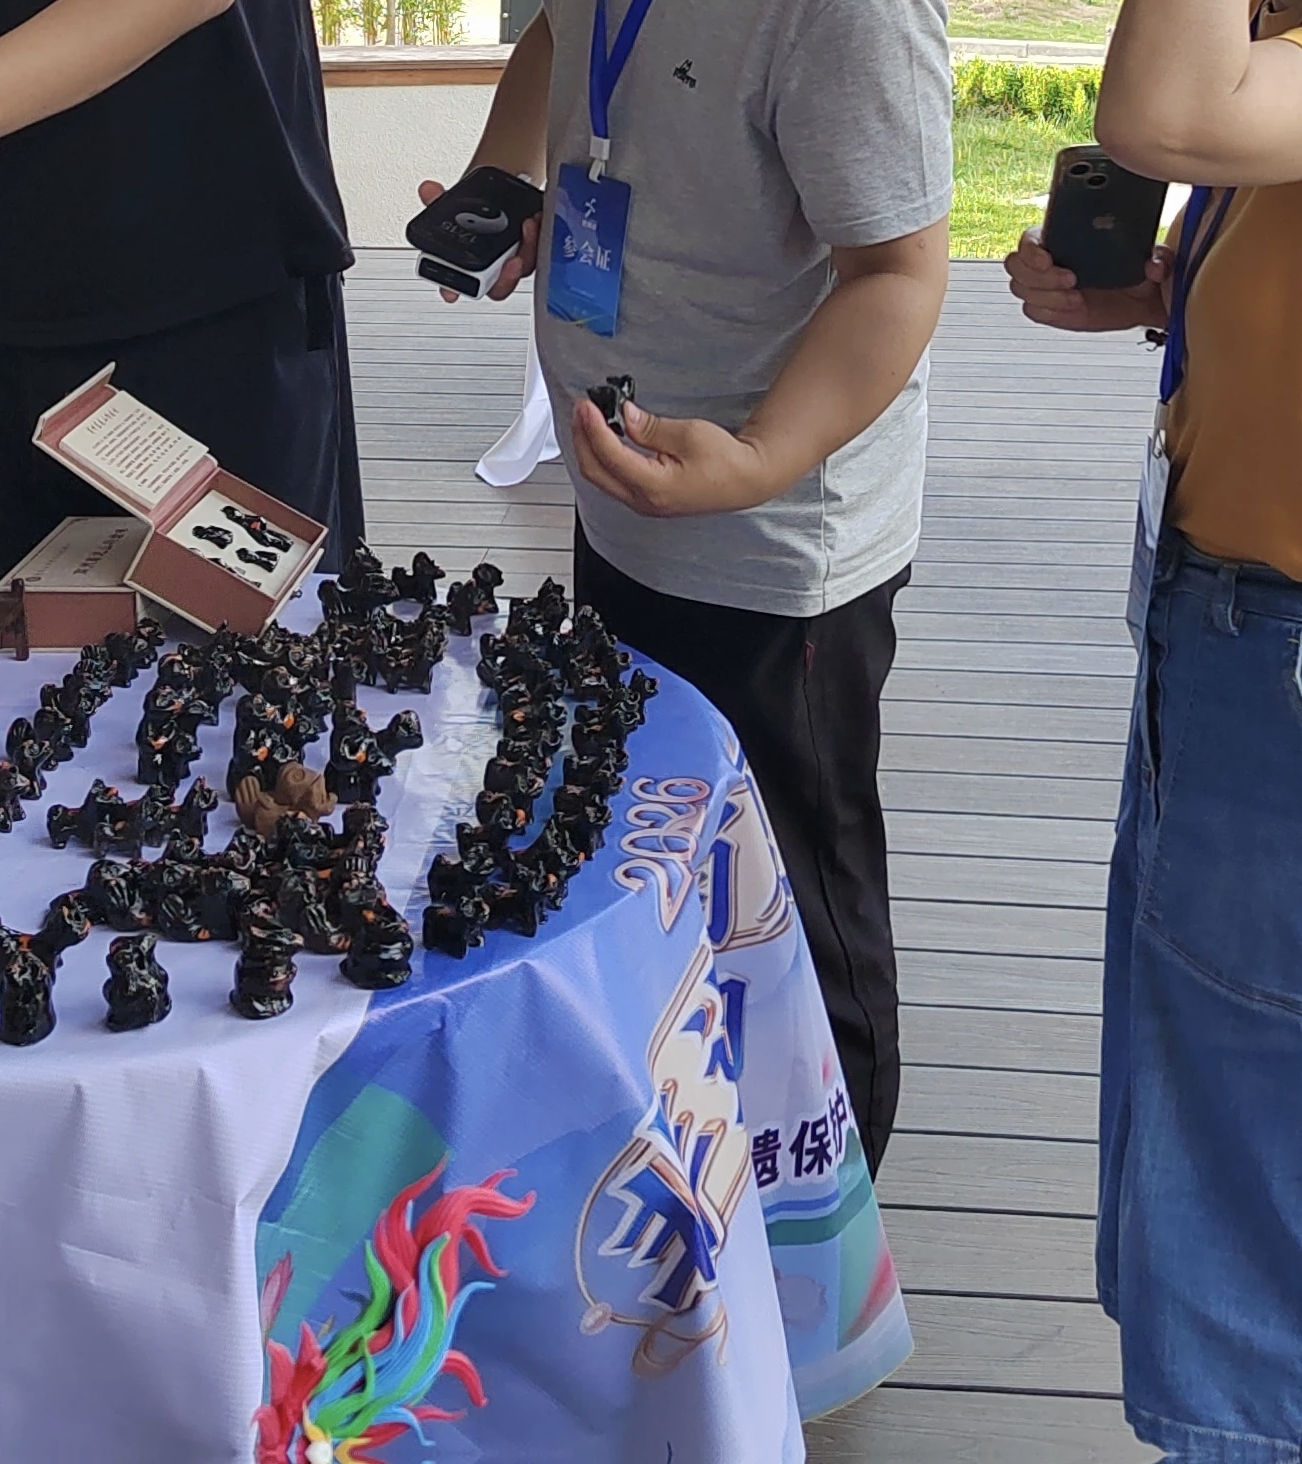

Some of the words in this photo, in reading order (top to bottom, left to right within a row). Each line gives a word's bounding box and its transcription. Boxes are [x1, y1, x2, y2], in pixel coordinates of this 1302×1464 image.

[562, 234, 612, 273] 参会证
[613, 776, 711, 933] 2026
